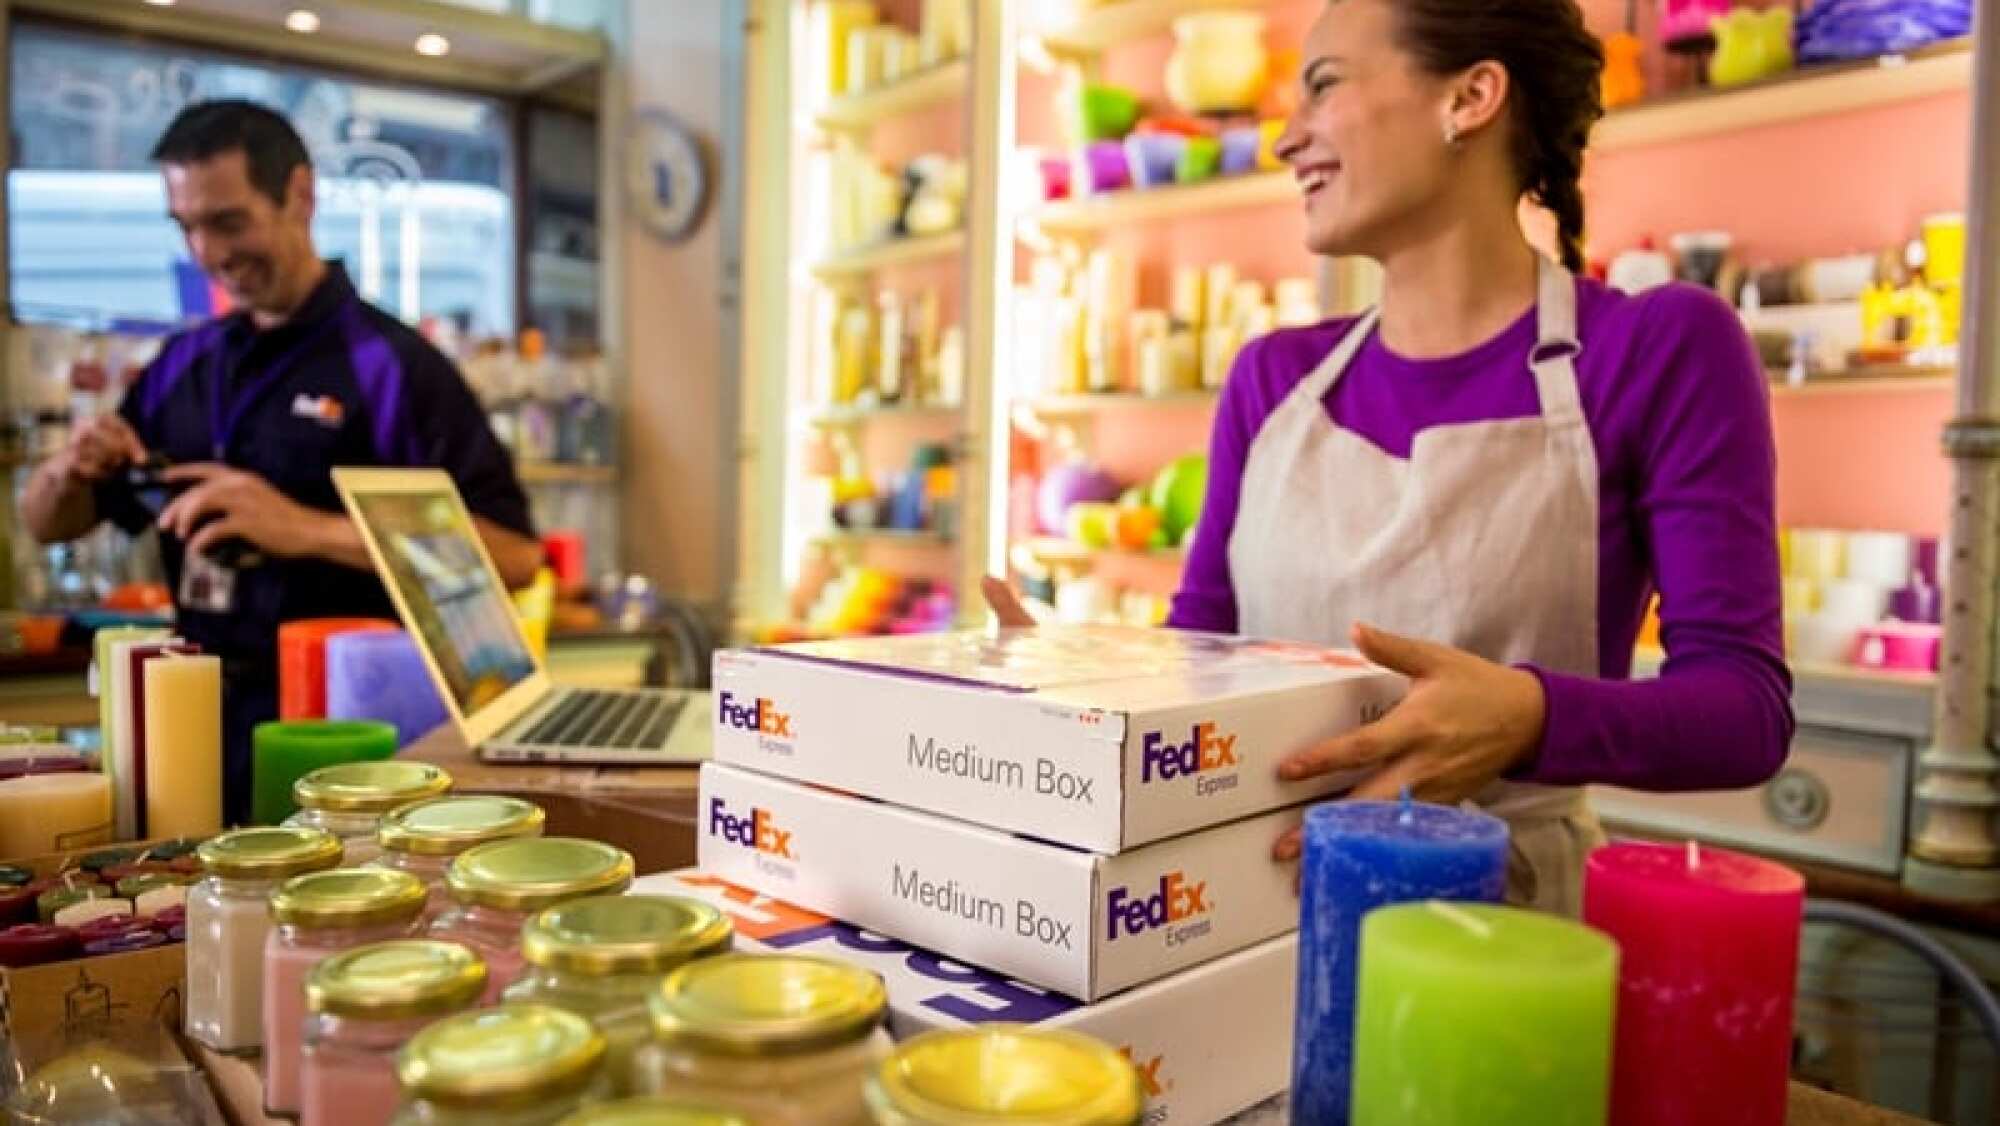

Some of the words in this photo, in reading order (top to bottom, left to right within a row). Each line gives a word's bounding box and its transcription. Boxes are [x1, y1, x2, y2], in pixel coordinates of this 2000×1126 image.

[719, 691, 791, 737] FedEx
[907, 733, 1024, 789] Medium
[1036, 757, 1094, 804] Box
[1142, 722, 1238, 784] FedEx
[709, 796, 791, 859] FedEx
[892, 864, 1004, 929] Medium
[1016, 899, 1071, 951] Box
[1106, 871, 1207, 941] FedEx
